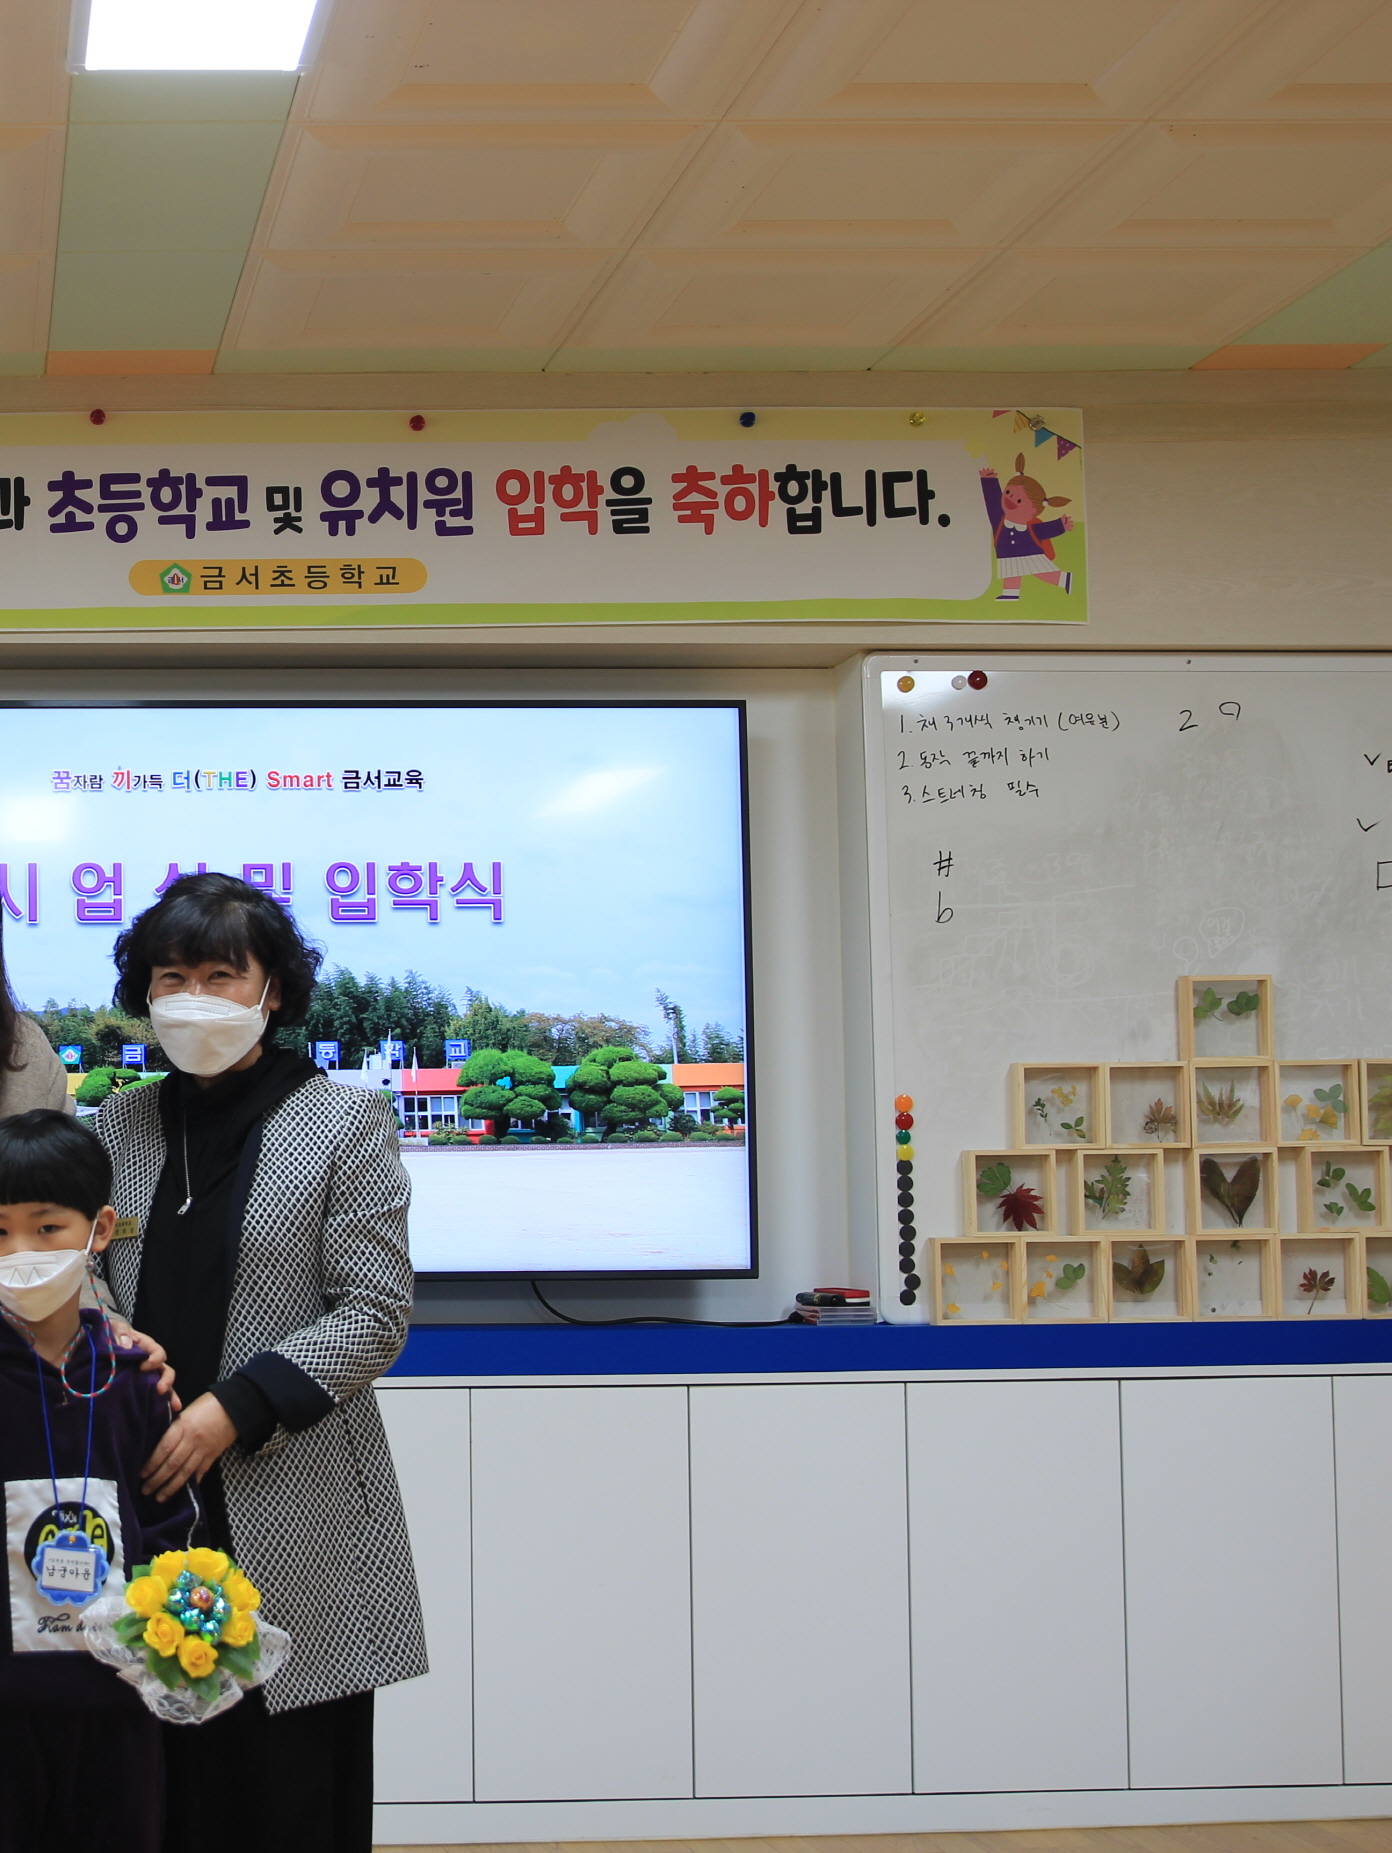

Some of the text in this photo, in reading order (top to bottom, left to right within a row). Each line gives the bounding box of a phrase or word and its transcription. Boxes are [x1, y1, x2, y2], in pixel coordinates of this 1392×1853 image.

[47, 467, 251, 544] 초등학교
[265, 485, 304, 536] 및
[319, 466, 474, 537] 유치원
[495, 464, 653, 537] 입학을
[671, 463, 951, 536] 축하합니다.
[199, 563, 400, 591] 금서초등학교
[900, 713, 913, 734] 1.
[1002, 712, 1049, 731] 챙기기
[897, 747, 1050, 771] 2. 동작 끝까지 하기
[52, 768, 424, 790] 꿈자람 끼가득 더(THE) Smart 금서교육
[901, 784, 916, 804] 3.
[1006, 780, 1040, 798] 필수
[325, 861, 504, 923] 입학식
